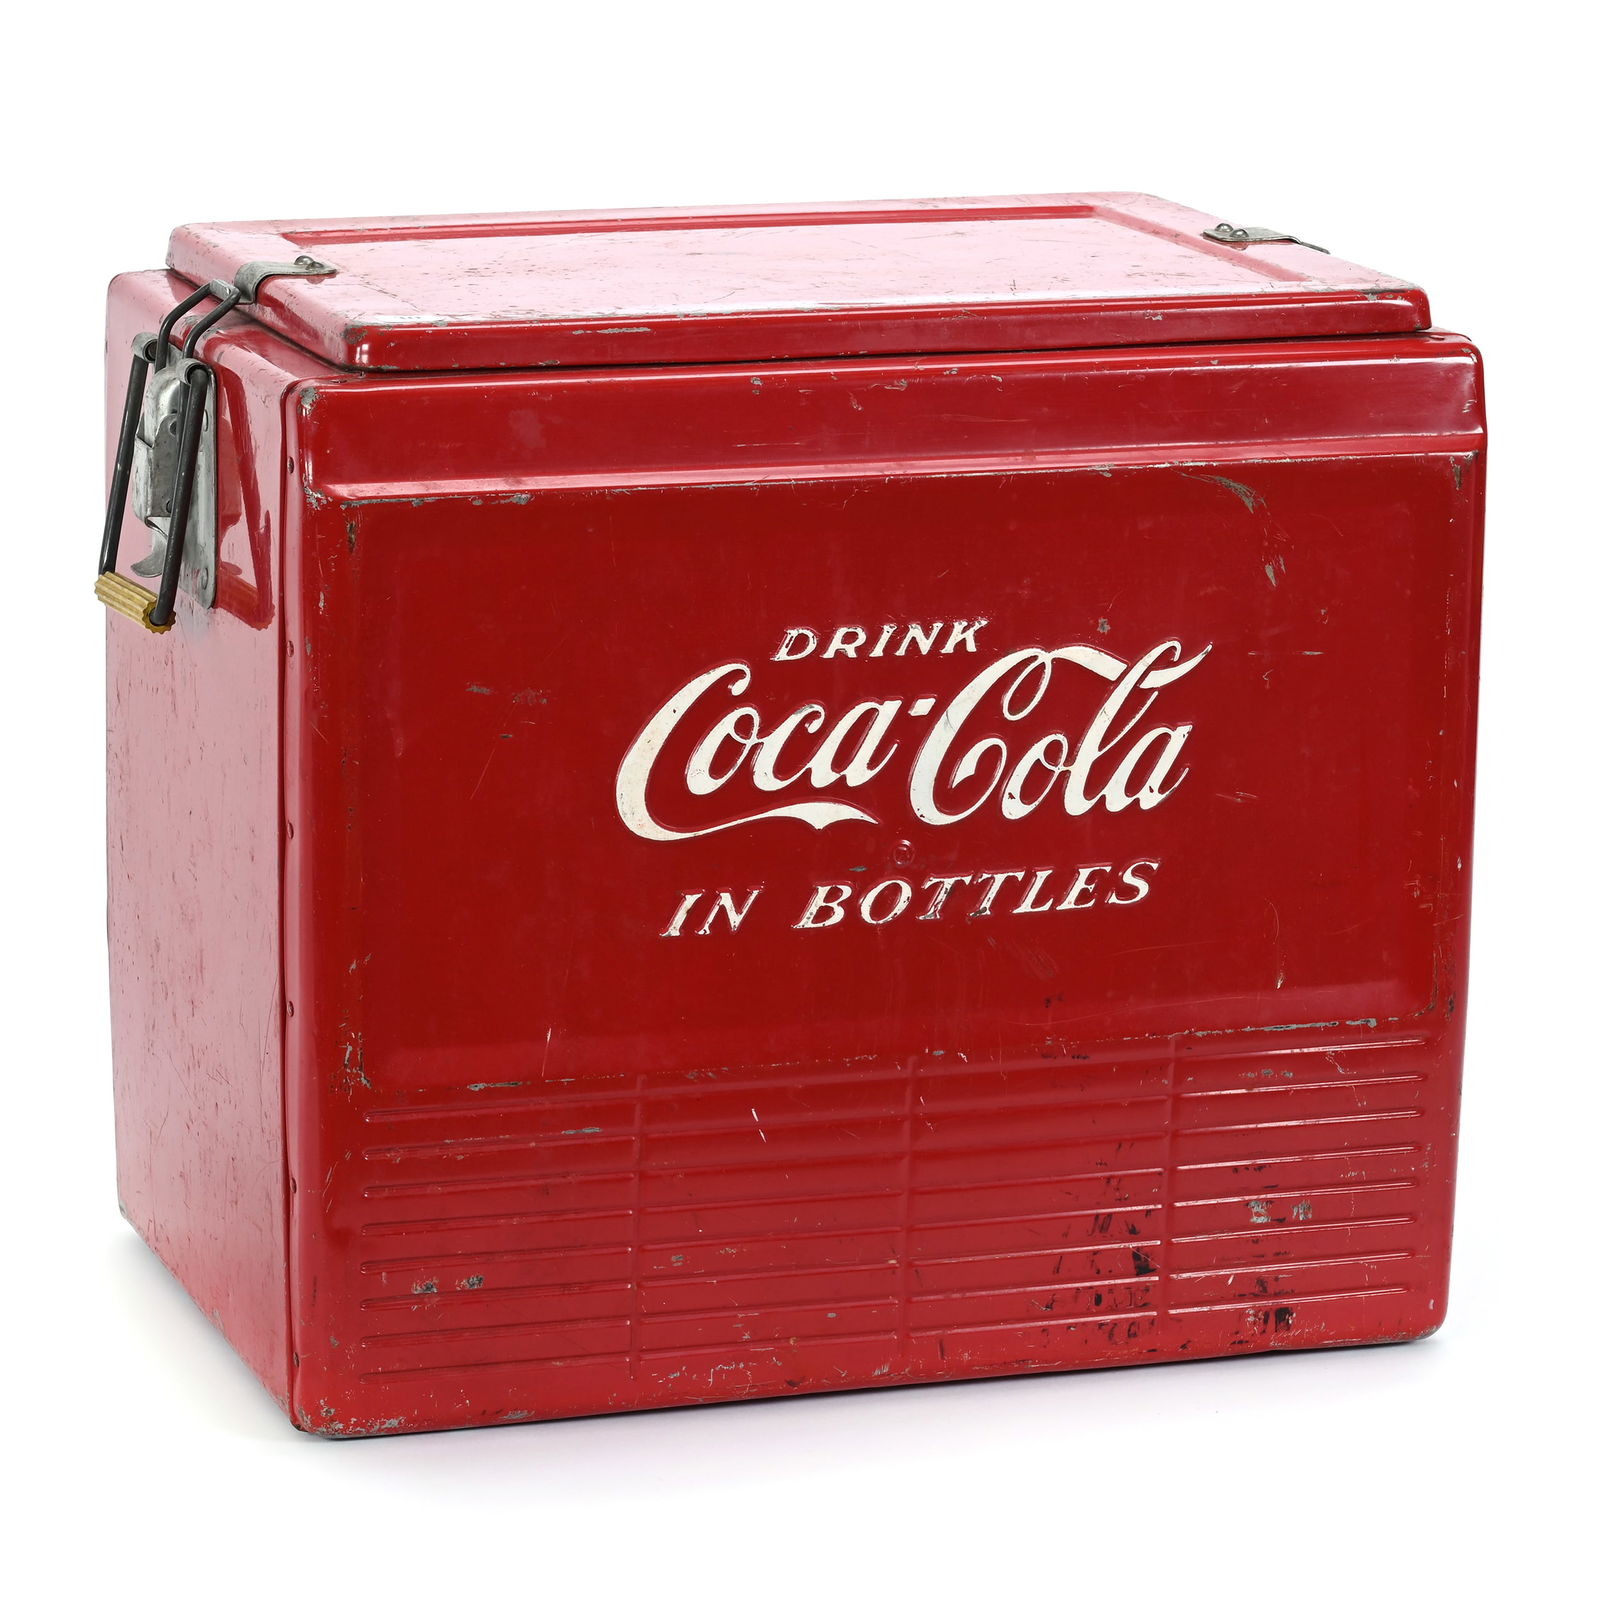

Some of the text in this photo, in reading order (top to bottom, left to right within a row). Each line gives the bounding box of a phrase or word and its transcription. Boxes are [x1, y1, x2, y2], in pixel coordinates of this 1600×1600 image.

[770, 617, 988, 661] DRINK
[616, 641, 1212, 841] Coca-Cola
[660, 859, 1160, 937] IN BOTTLES
